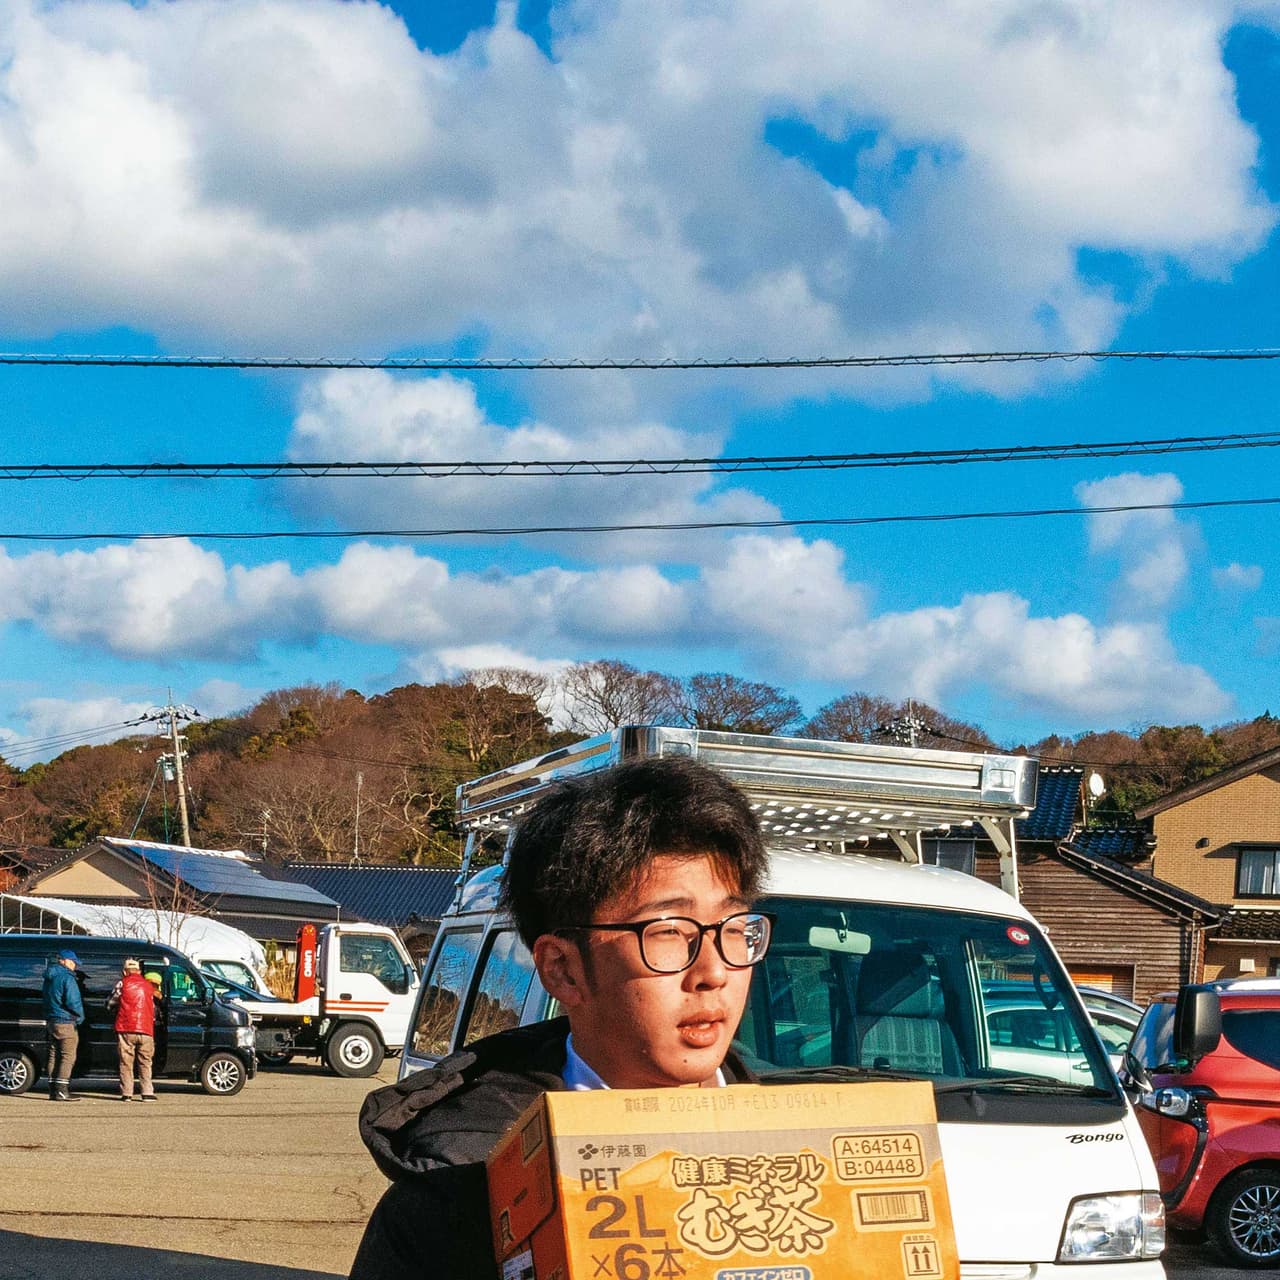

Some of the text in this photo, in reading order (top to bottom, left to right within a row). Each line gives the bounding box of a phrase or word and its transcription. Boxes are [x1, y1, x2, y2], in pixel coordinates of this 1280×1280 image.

[841, 1138, 913, 1155] A:64514
[1065, 1133, 1124, 1144] Bongo
[600, 1144, 648, 1159] 伊藤園
[672, 1154, 825, 1188] 健康ミネラル
[844, 1158, 916, 1176] B:04448
[580, 1167, 621, 1192] PET
[585, 1195, 667, 1239] 2L
[677, 1180, 835, 1255] むぎ茶
